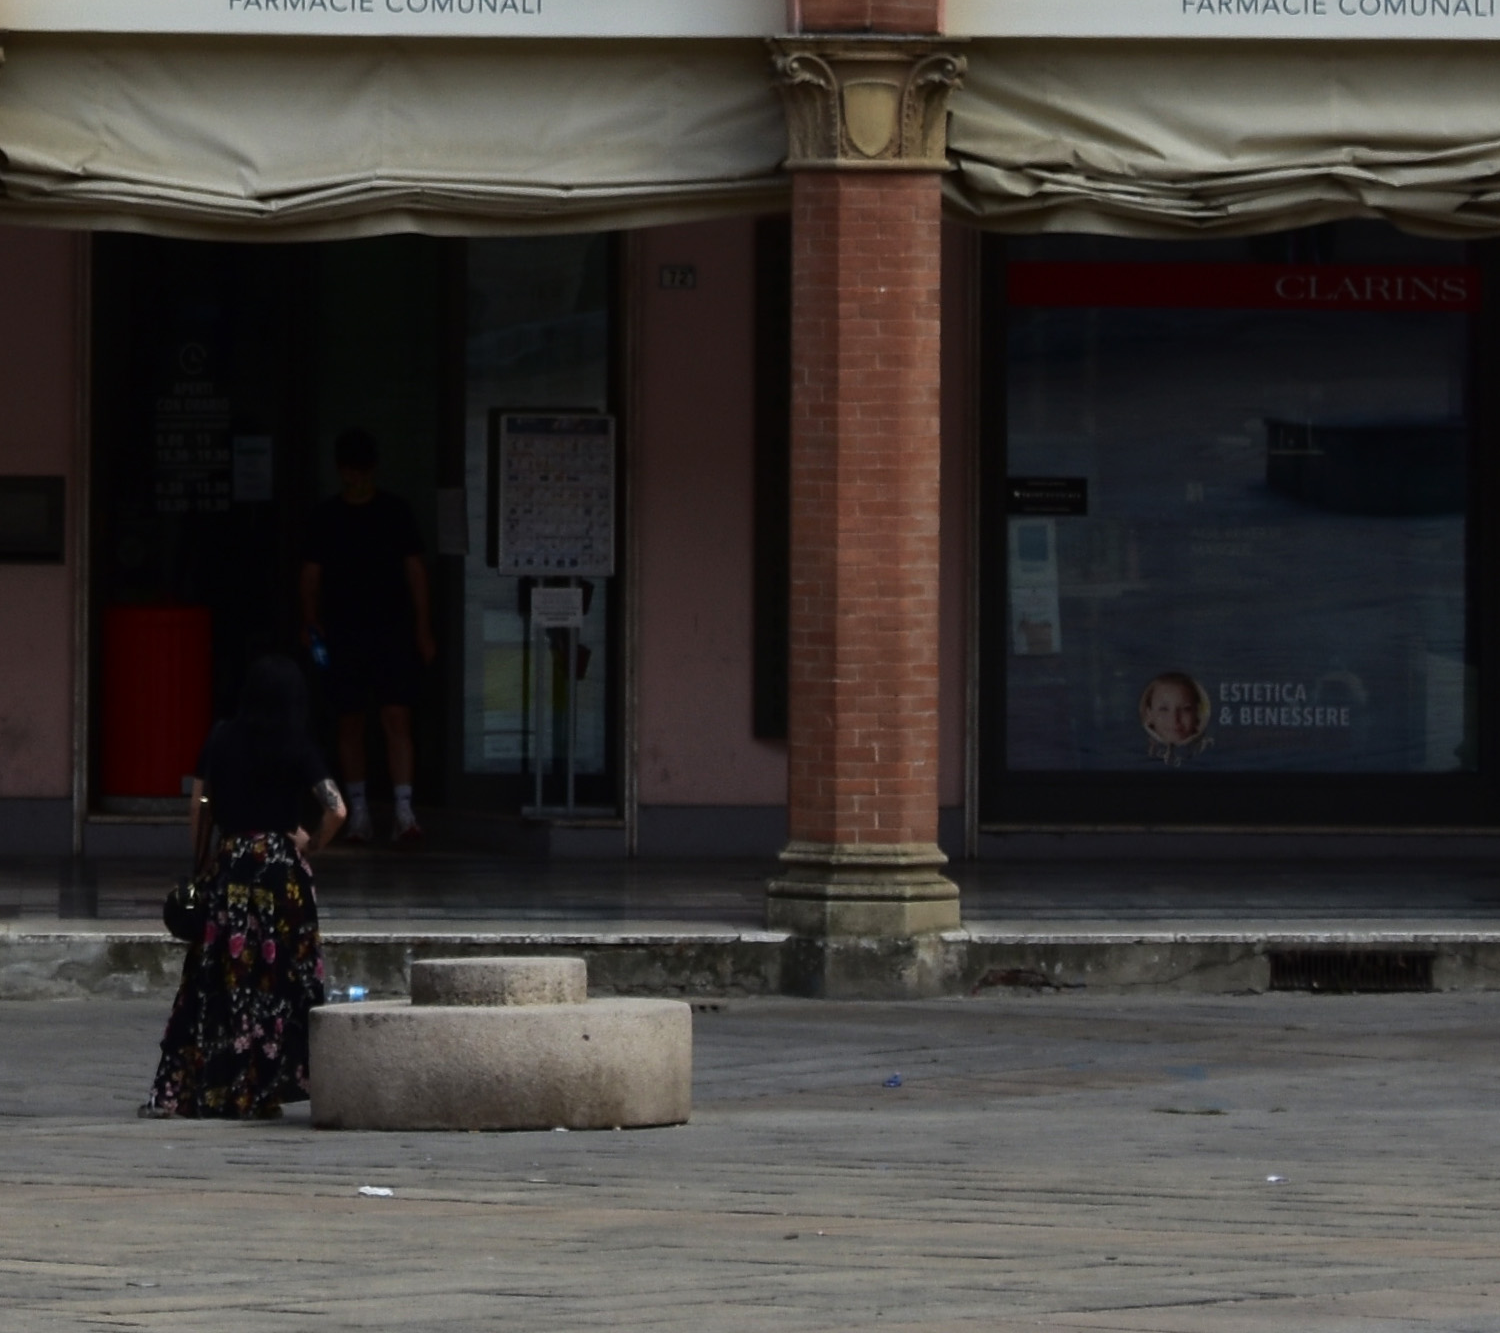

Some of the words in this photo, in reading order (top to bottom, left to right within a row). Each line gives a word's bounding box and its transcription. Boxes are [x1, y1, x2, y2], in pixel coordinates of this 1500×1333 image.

[1275, 276, 1468, 302] CLARINS
[1220, 682, 1306, 702] ESTETICA
[1219, 707, 1232, 725] &
[1240, 706, 1350, 726] BENESSERE
